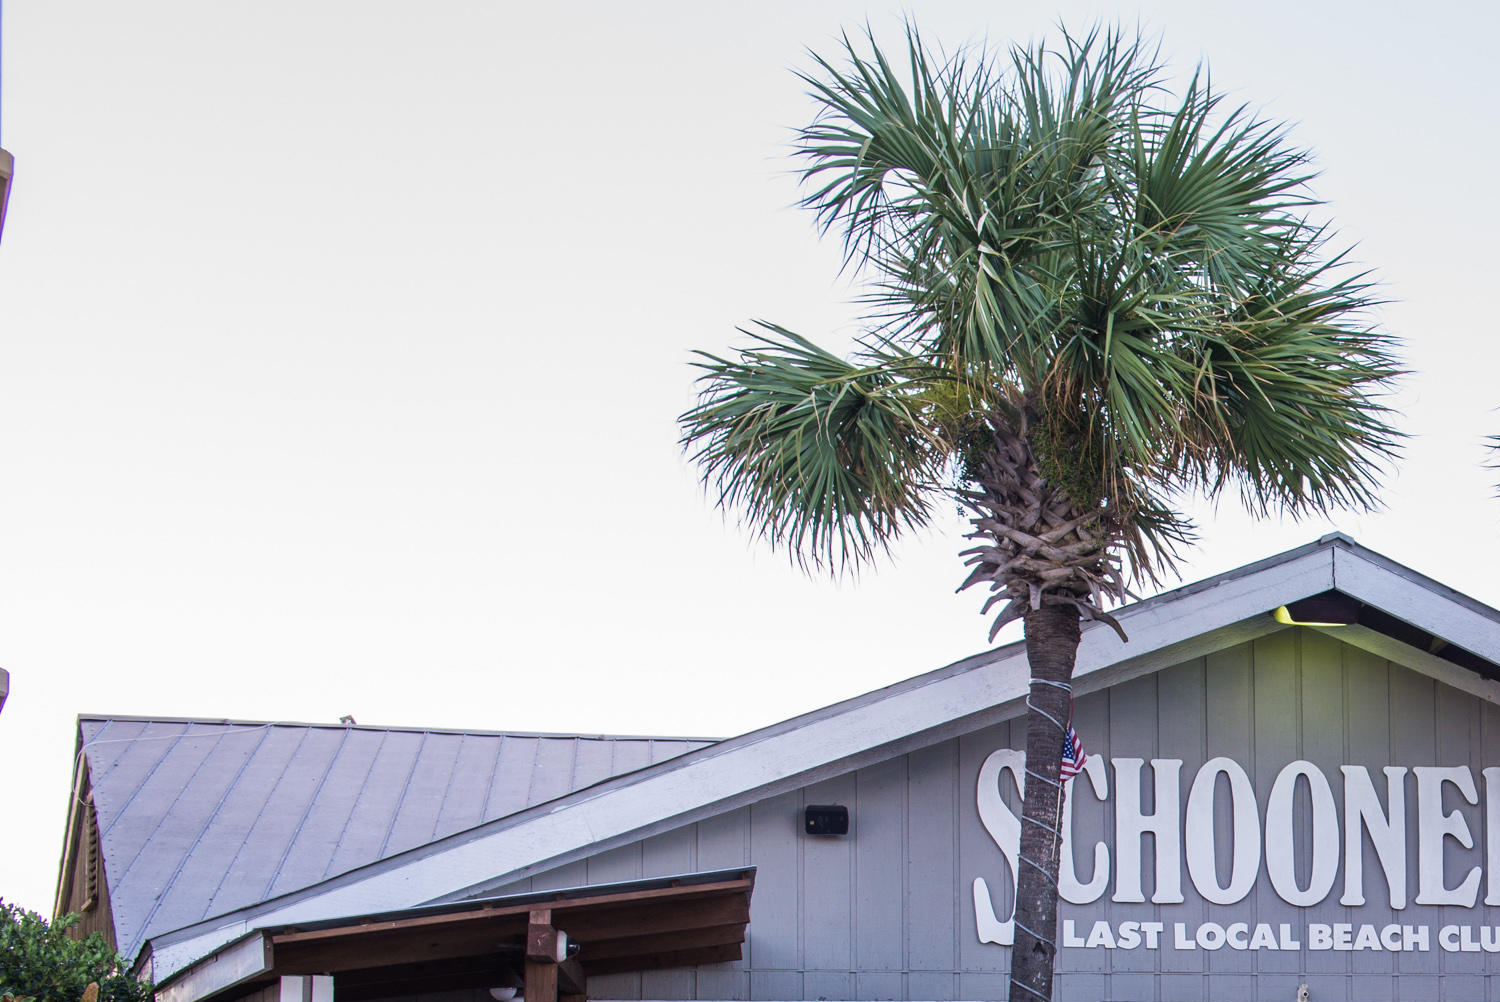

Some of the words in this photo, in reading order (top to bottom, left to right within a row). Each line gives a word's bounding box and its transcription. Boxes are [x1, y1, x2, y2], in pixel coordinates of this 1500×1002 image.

[1063, 919, 1163, 950] LAST
[1175, 921, 1300, 952] LOCAL
[1309, 923, 1430, 953] BEACH
